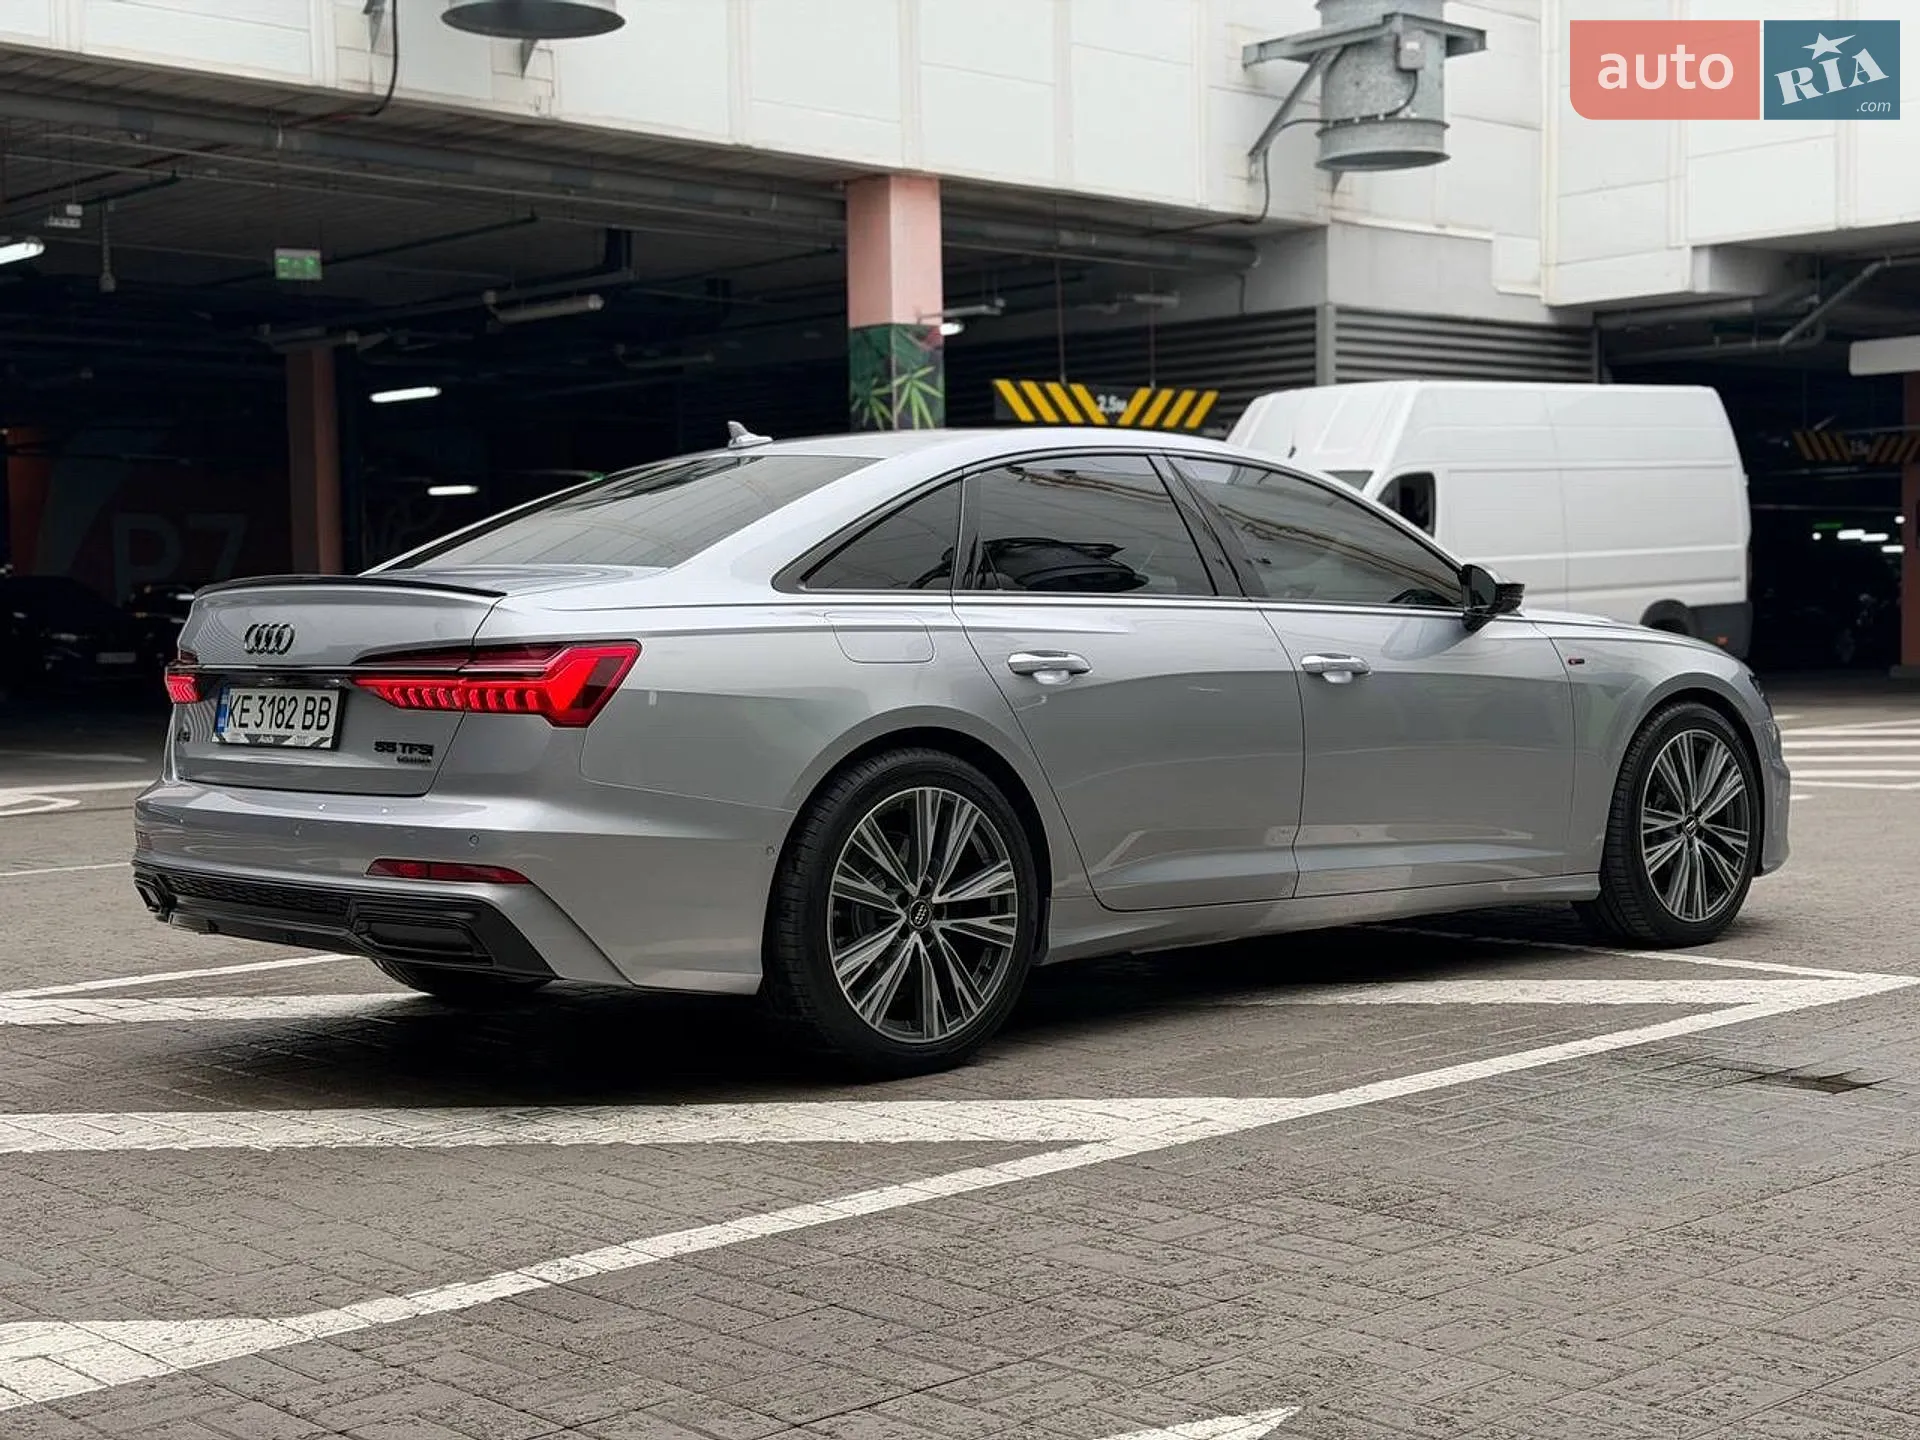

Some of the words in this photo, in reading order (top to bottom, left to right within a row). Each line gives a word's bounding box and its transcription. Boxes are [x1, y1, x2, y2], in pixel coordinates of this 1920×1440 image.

[227, 695, 252, 728] KE
[254, 695, 298, 730] 3182
[301, 696, 332, 731] BB
[374, 741, 397, 753] 55
